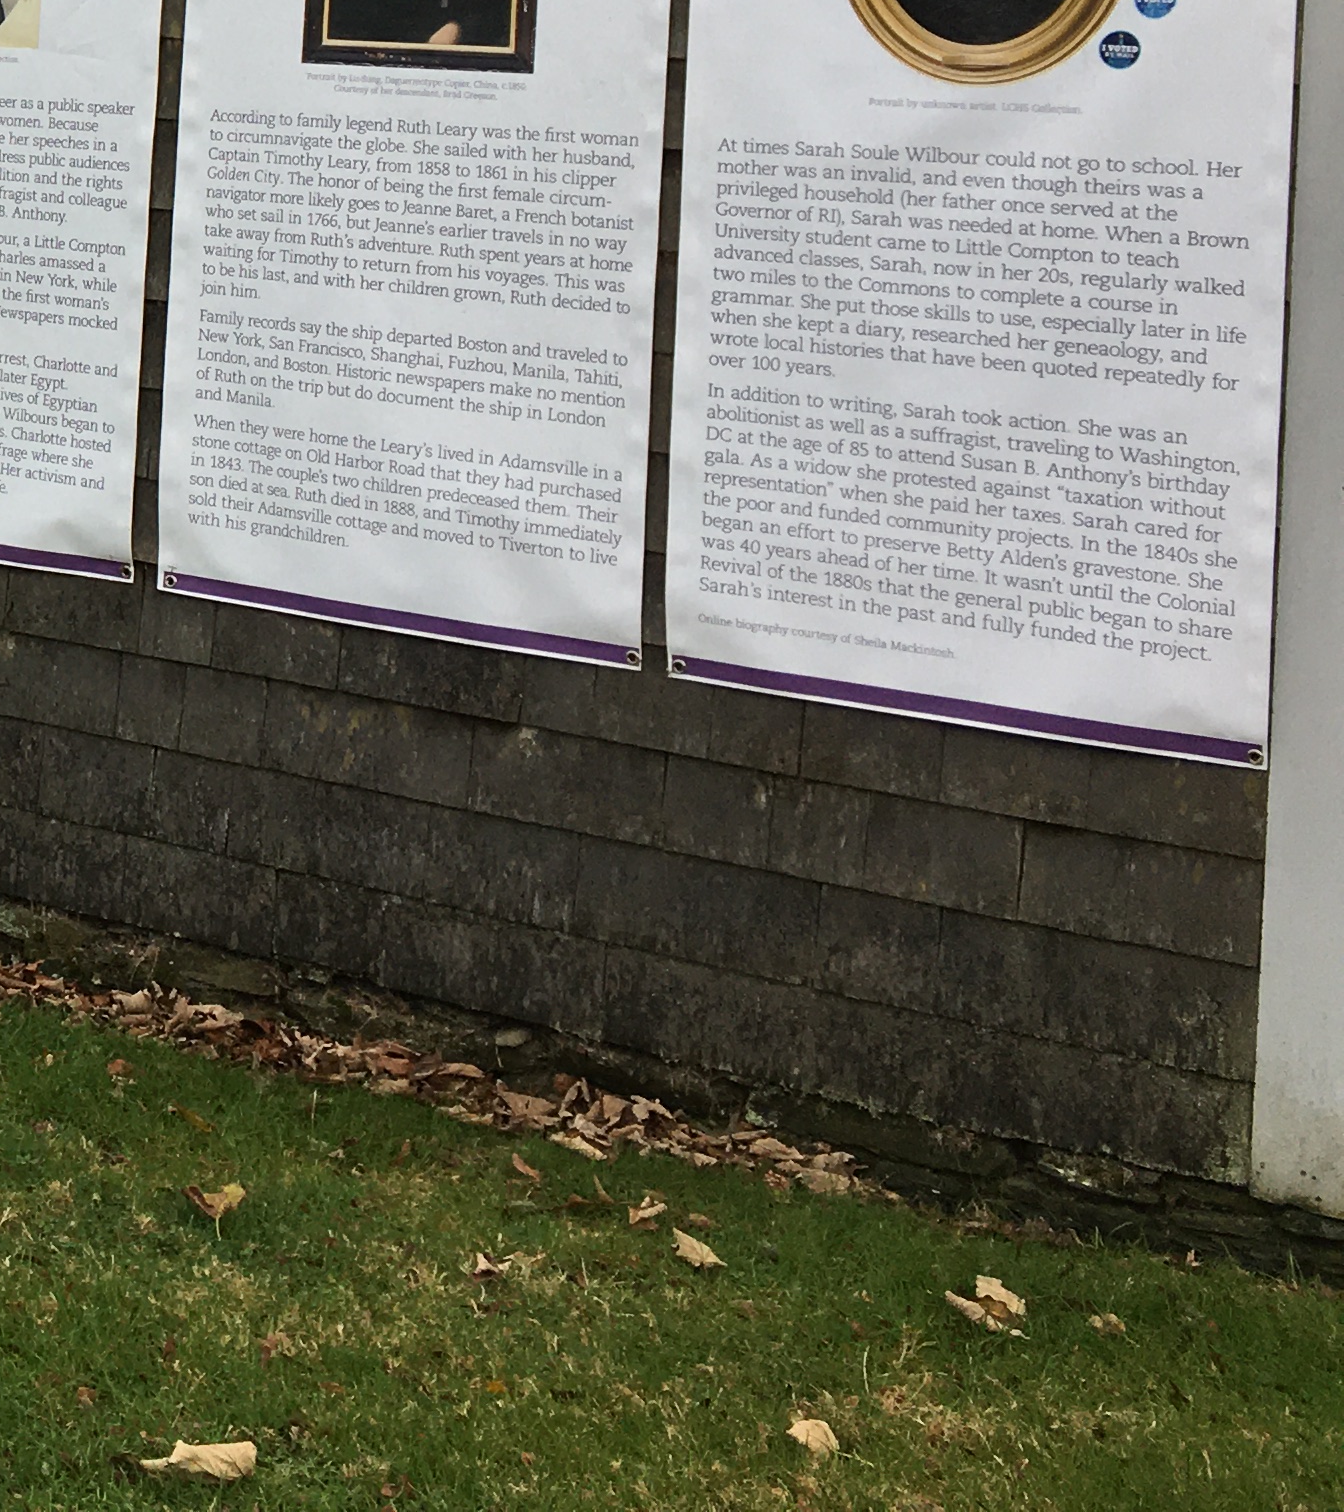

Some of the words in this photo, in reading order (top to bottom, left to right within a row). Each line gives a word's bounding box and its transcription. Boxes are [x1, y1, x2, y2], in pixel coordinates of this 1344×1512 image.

[1108, 44, 1139, 52] VOTED
[20, 98, 33, 109] as
[36, 99, 44, 110] a
[47, 97, 84, 114] public
[86, 100, 135, 116] speaker
[209, 108, 276, 129] According
[278, 113, 292, 126] to
[296, 113, 341, 133] family
[345, 115, 392, 134] legend
[396, 118, 431, 134] Ruth
[436, 121, 478, 141] Leary
[481, 126, 511, 139] was
[515, 124, 540, 141] the
[544, 126, 575, 143] first
[580, 132, 638, 147] woman
[717, 137, 737, 152] At
[742, 139, 789, 155] times
[794, 140, 844, 158] Sarah
[850, 143, 899, 161] Soule
[904, 146, 980, 165] Wilbour
[985, 150, 1035, 168] could
[1041, 155, 1072, 169] not
[1076, 158, 1100, 175] go
[1105, 157, 1125, 172] to
[1131, 156, 1198, 176] school.
[1206, 160, 1243, 178] Her
[22, 236, 30, 246] a
[34, 234, 65, 250] Little
[68, 238, 125, 257] Compton
[199, 283, 226, 297] join
[230, 283, 260, 299] him.
[197, 327, 229, 343] New
[232, 331, 265, 349] York,
[268, 335, 294, 351] San
[298, 338, 365, 361] Francisco,
[370, 346, 443, 369] Shanghai,
[448, 354, 507, 376] Fuzhou,
[512, 361, 568, 383] Manila,
[574, 368, 622, 389] Tahiti,
[697, 612, 733, 626] Online
[735, 617, 789, 636] biography
[790, 628, 838, 644] courtesy
[839, 633, 851, 643] of
[853, 634, 887, 649] Sheila
[767, 588, 833, 608] interest
[838, 598, 856, 611] in
[862, 598, 892, 616] the
[897, 606, 935, 622] past
[941, 611, 975, 628] and
[981, 613, 1024, 638] fully
[1030, 619, 1096, 645] funded
[1102, 630, 1133, 650] the
[1139, 639, 1211, 661] project.
